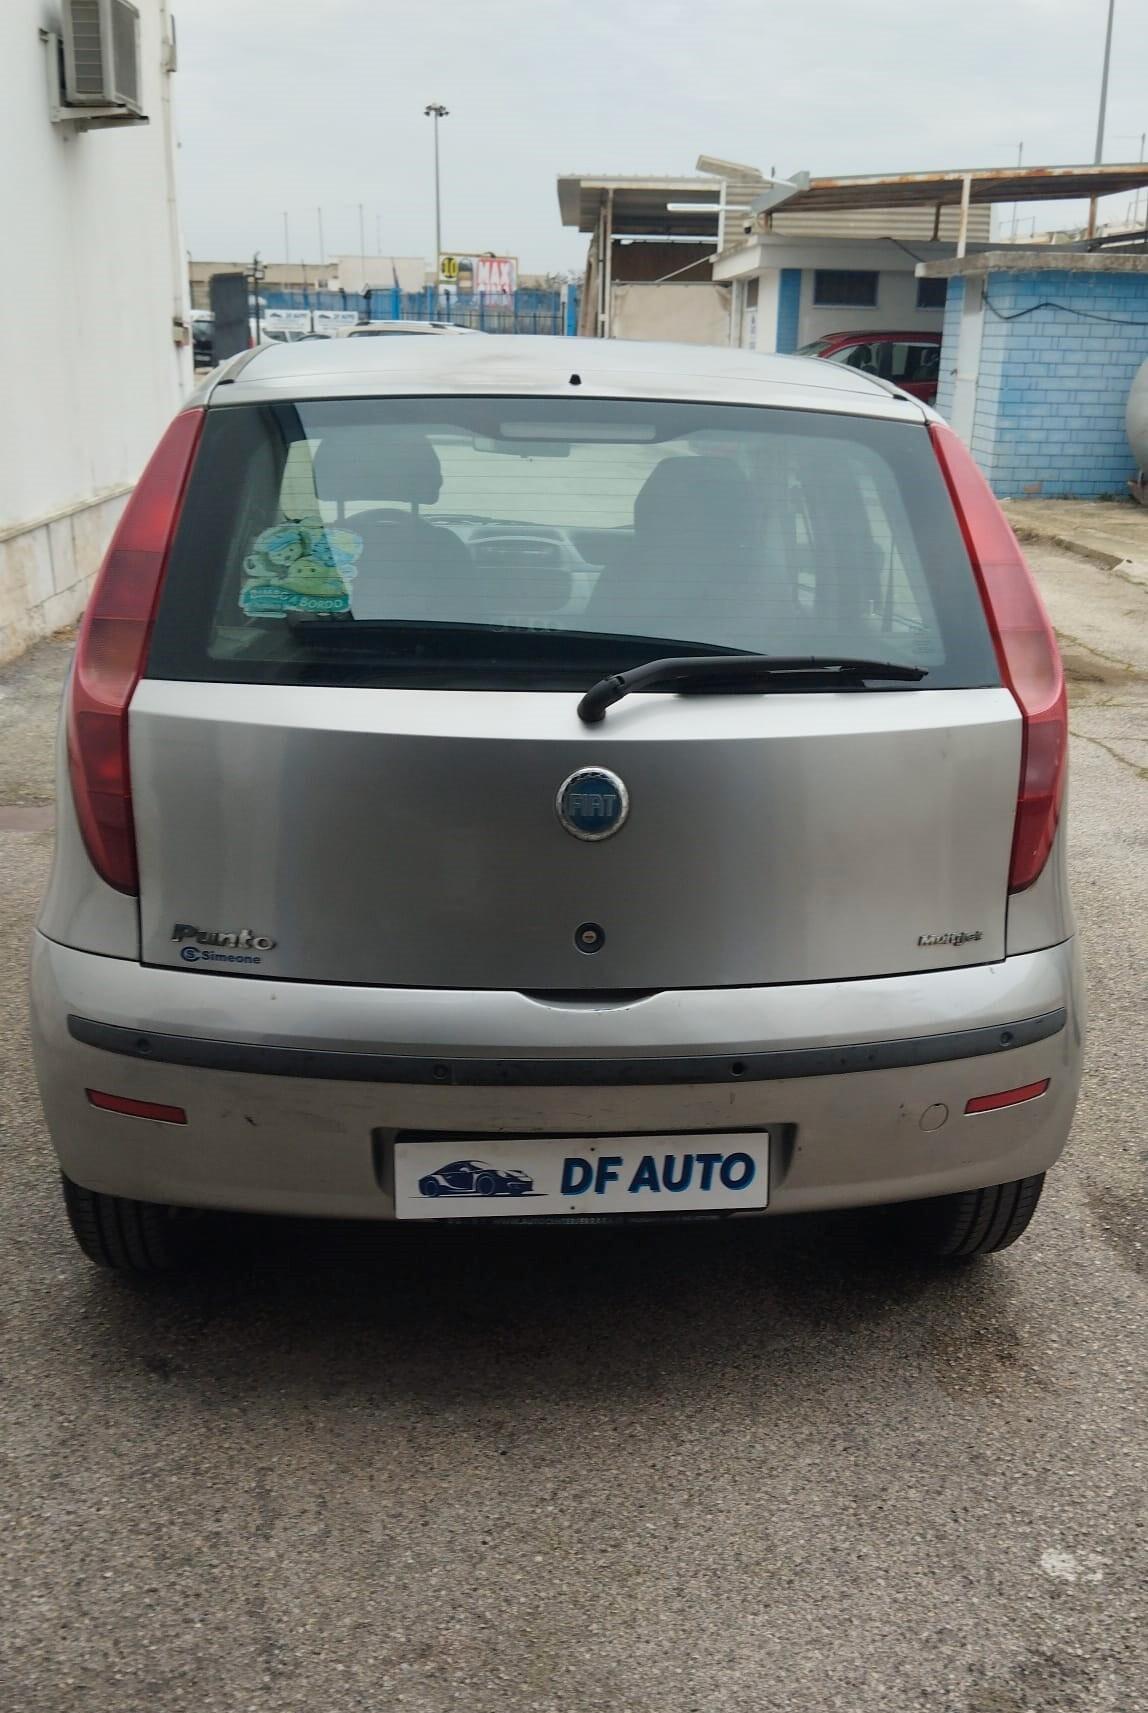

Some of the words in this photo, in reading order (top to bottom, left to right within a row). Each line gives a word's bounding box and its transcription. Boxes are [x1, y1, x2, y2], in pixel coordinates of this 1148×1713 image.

[568, 793, 616, 817] FIAT
[170, 923, 277, 950] Punto
[201, 951, 261, 964] Simeone
[560, 1156, 624, 1196] DF
[628, 1152, 756, 1194] AUTO
